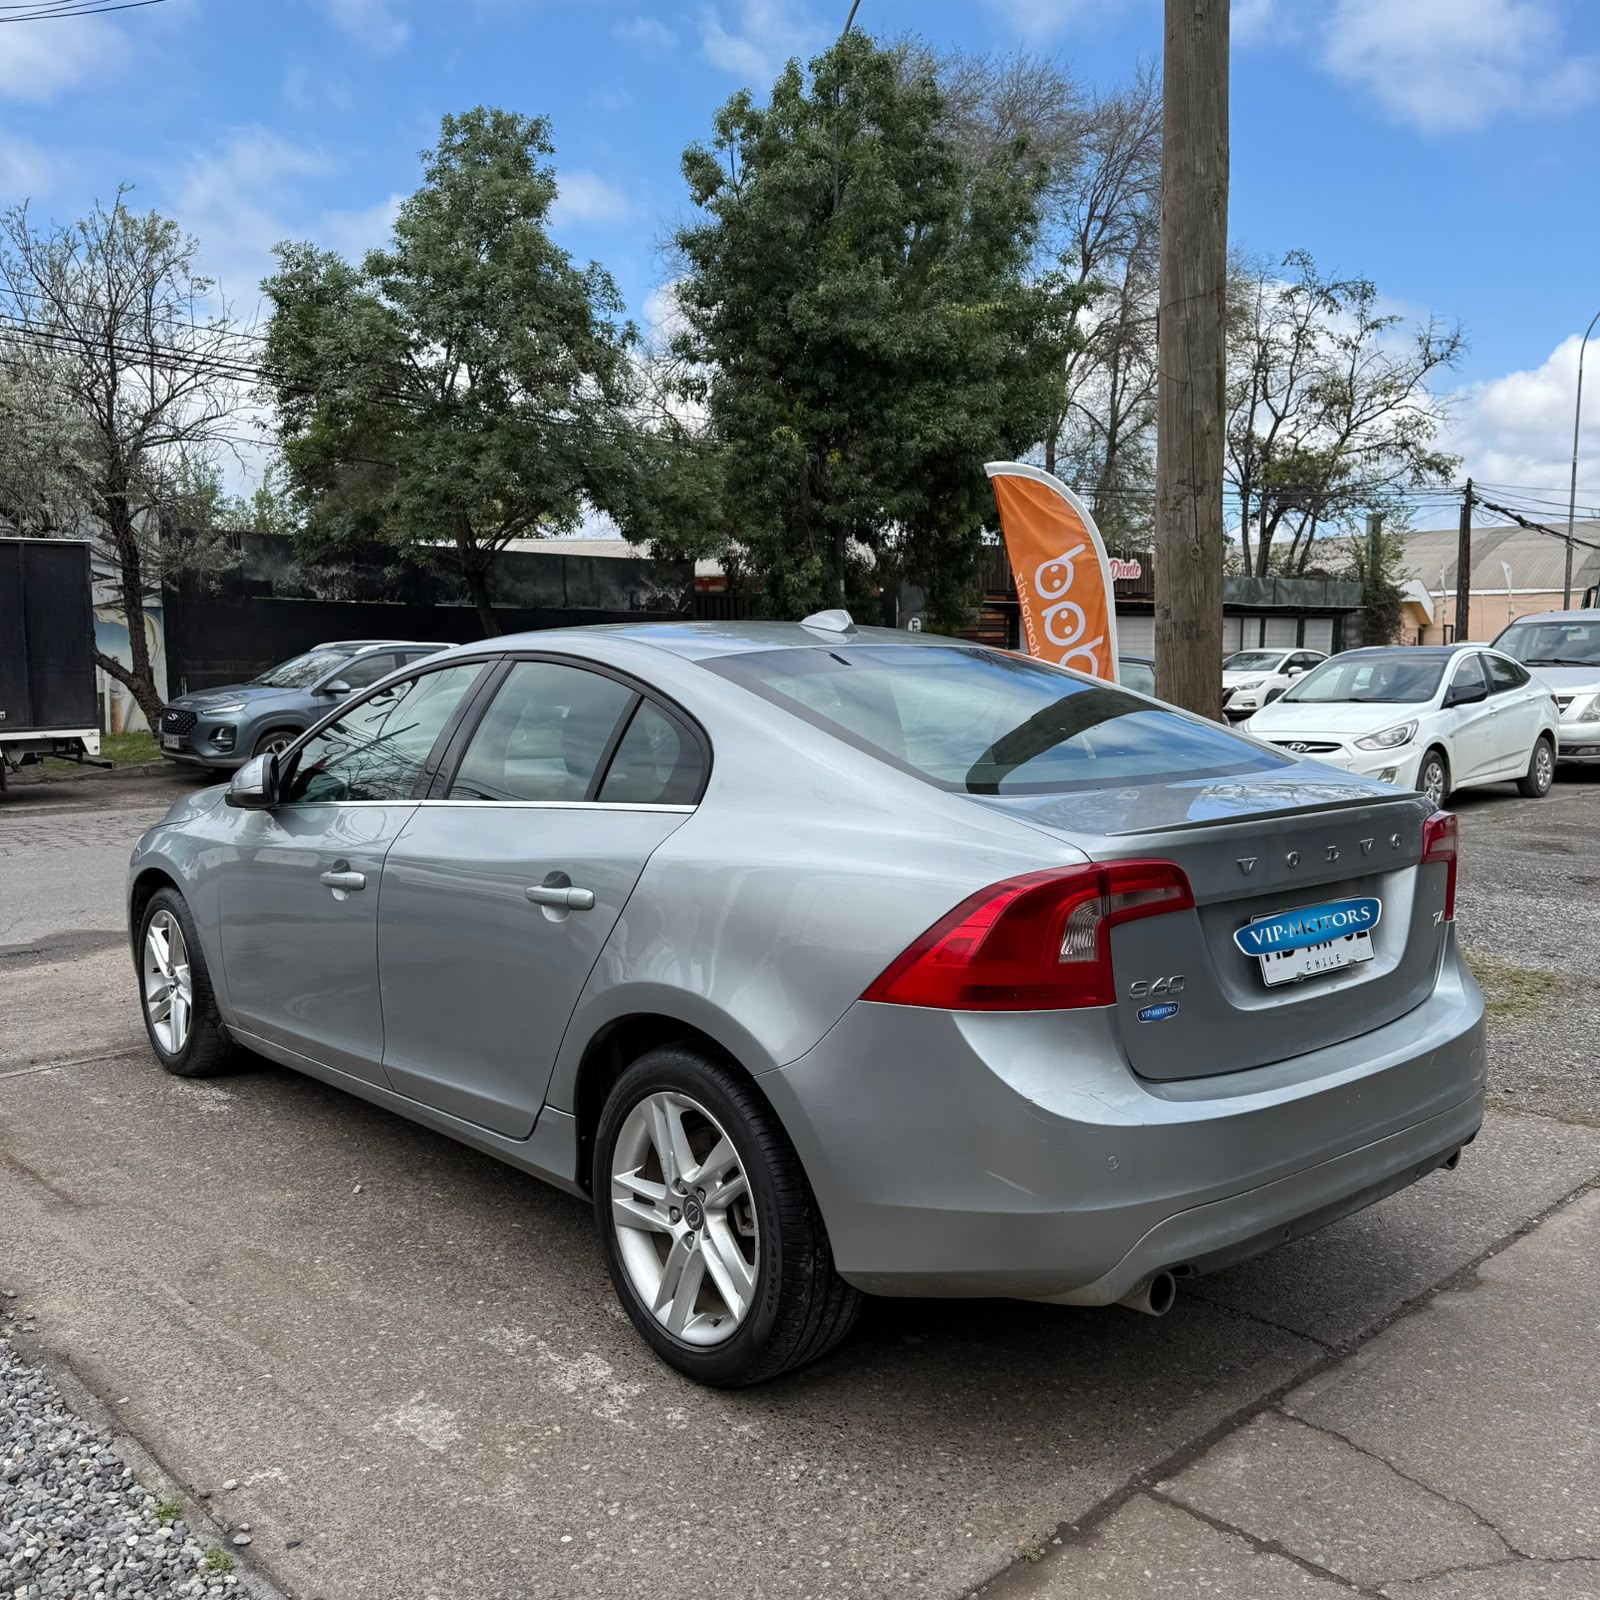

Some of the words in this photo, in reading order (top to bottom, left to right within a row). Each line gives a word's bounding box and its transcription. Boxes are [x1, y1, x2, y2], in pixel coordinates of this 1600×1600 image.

[1109, 559, 1140, 580] Diente
[1236, 833, 1401, 875] VOLVO
[1305, 953, 1342, 971] CHILE
[1130, 975, 1185, 999] S60
